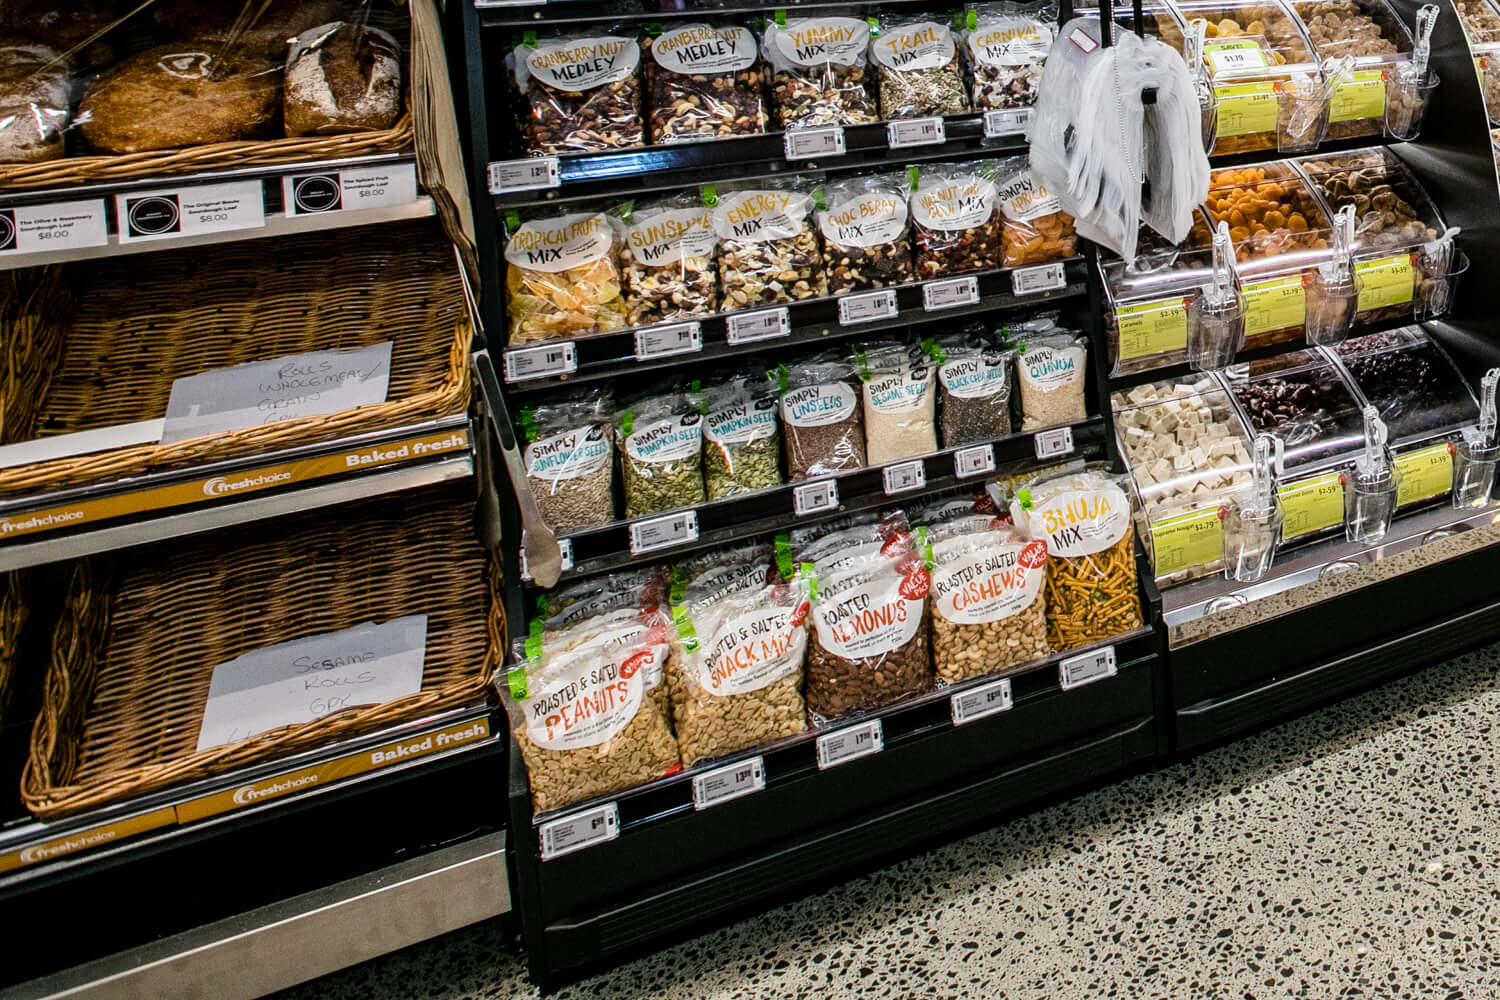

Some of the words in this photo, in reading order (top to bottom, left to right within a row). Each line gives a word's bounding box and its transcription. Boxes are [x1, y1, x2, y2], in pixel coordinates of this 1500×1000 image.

[656, 26, 718, 54] CRANBERRY
[722, 28, 743, 42] NUT
[789, 25, 856, 48] YUMMY
[976, 25, 1040, 48] CARNIVAL
[531, 48, 598, 70] CRANBERRY
[600, 41, 626, 58] NUT
[676, 40, 737, 64] MEDLEY
[551, 56, 616, 80] MEDLEY
[360, 189, 384, 197] $8.00
[200, 214, 228, 223] $8.00
[727, 193, 791, 224] ENERGY
[828, 207, 857, 228] CHOC
[860, 200, 897, 217] BERRY
[38, 230, 69, 240] $8.00
[511, 227, 569, 251] TROPICAL
[570, 219, 601, 241] FRUIT
[1030, 359, 1074, 378] QUINOA
[871, 388, 903, 406] SESAME
[713, 416, 751, 437] PUMPKIN
[346, 444, 408, 467] Baked
[413, 435, 464, 455] fresh
[637, 434, 678, 457] PUMPKIN
[218, 471, 291, 495] freshchoice
[1, 510, 84, 534] freshchoice
[1042, 496, 1111, 534] BHUJA
[1195, 522, 1214, 531] $2.79
[1022, 545, 1044, 564] VALUE
[1033, 554, 1048, 567] PACK
[936, 567, 974, 594] ROASTED
[975, 561, 983, 576] &
[985, 551, 1017, 573] SALTED
[903, 574, 927, 597] VALUE
[914, 583, 928, 597] PACK
[952, 567, 1027, 611] CASHEWS
[823, 594, 870, 624] ROASTED
[831, 601, 907, 643] ALMONDS
[704, 634, 738, 671] ROASTED
[739, 627, 748, 641] &
[751, 613, 787, 635] SALTED
[711, 646, 759, 689] SNACK
[305, 672, 376, 690] ROLLS
[534, 683, 578, 720] ROASTED
[580, 676, 589, 691] &
[545, 681, 628, 741] PEANUTS
[372, 738, 431, 764] Baked
[436, 724, 485, 747] fresh
[247, 774, 318, 801] freshchoice
[37, 830, 115, 859] freshchoice
